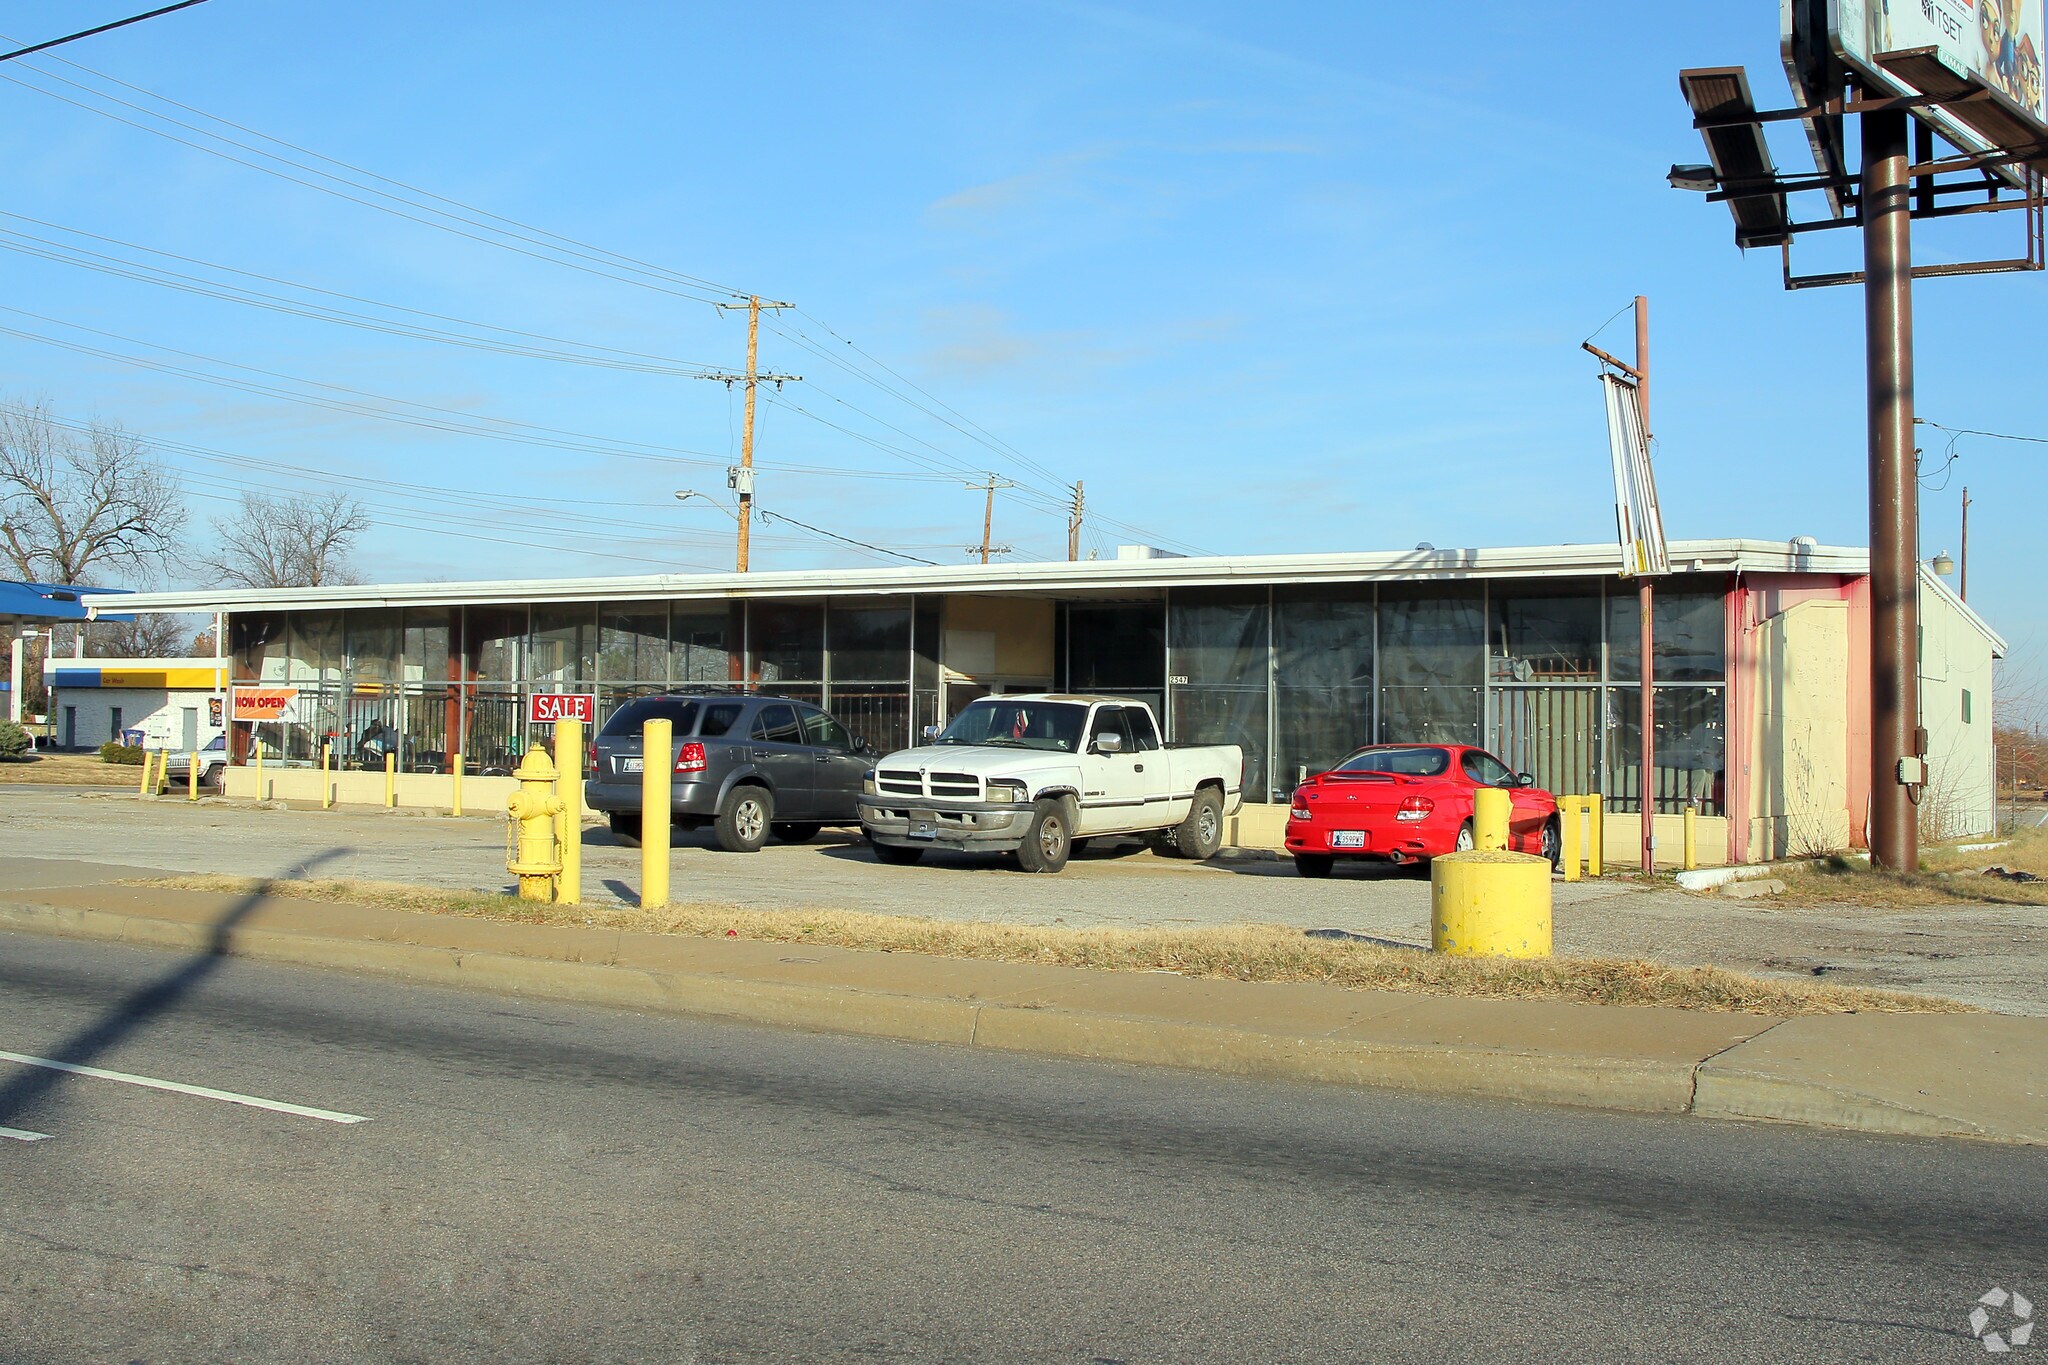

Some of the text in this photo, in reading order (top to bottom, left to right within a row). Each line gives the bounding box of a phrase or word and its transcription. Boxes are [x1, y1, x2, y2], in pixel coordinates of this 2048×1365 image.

[1936, 5, 1962, 44] TSET
[1941, 50, 1966, 76] LAMAR
[235, 697, 285, 708] NOW OPEN
[538, 697, 586, 719] SALE
